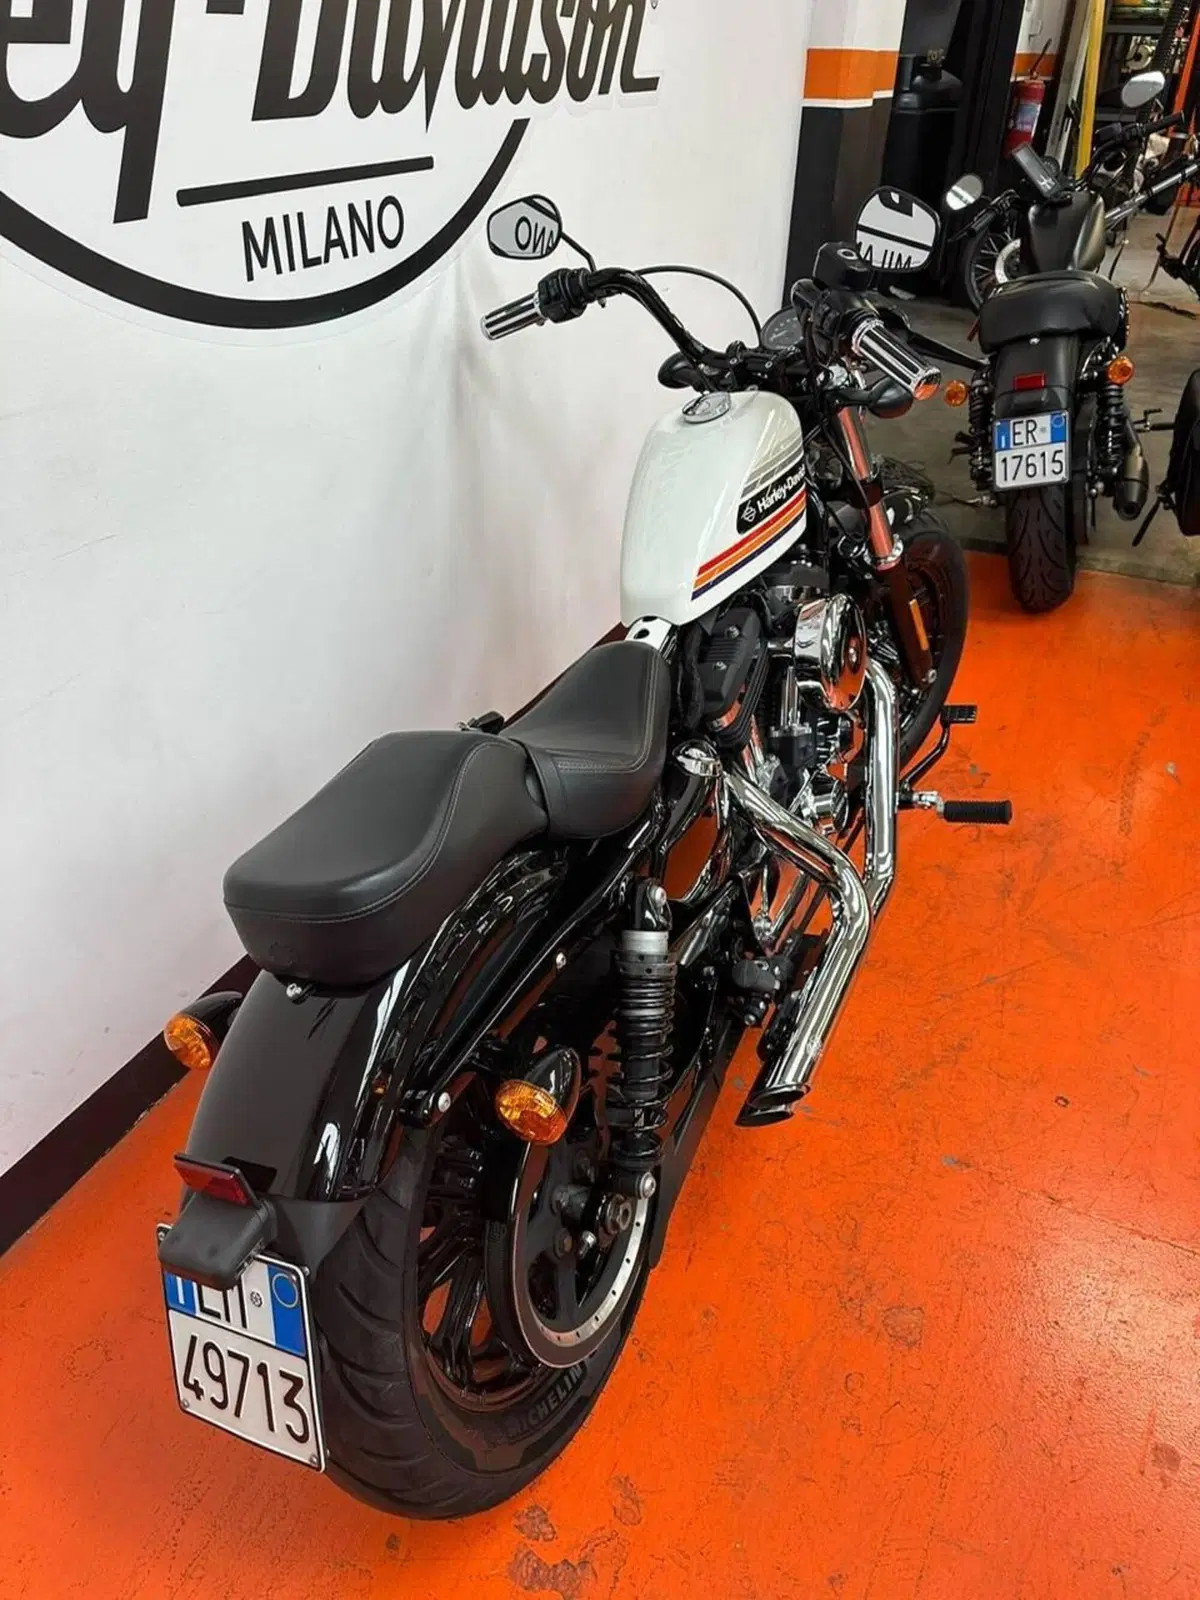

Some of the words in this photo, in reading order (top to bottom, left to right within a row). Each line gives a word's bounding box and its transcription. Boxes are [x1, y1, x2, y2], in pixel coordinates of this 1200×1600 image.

[242, 195, 405, 282] MILANO
[1001, 450, 1064, 482] 17615
[1012, 419, 1037, 446] ER
[183, 1334, 310, 1444] 49713
[507, 1361, 585, 1438] ICHELIN
